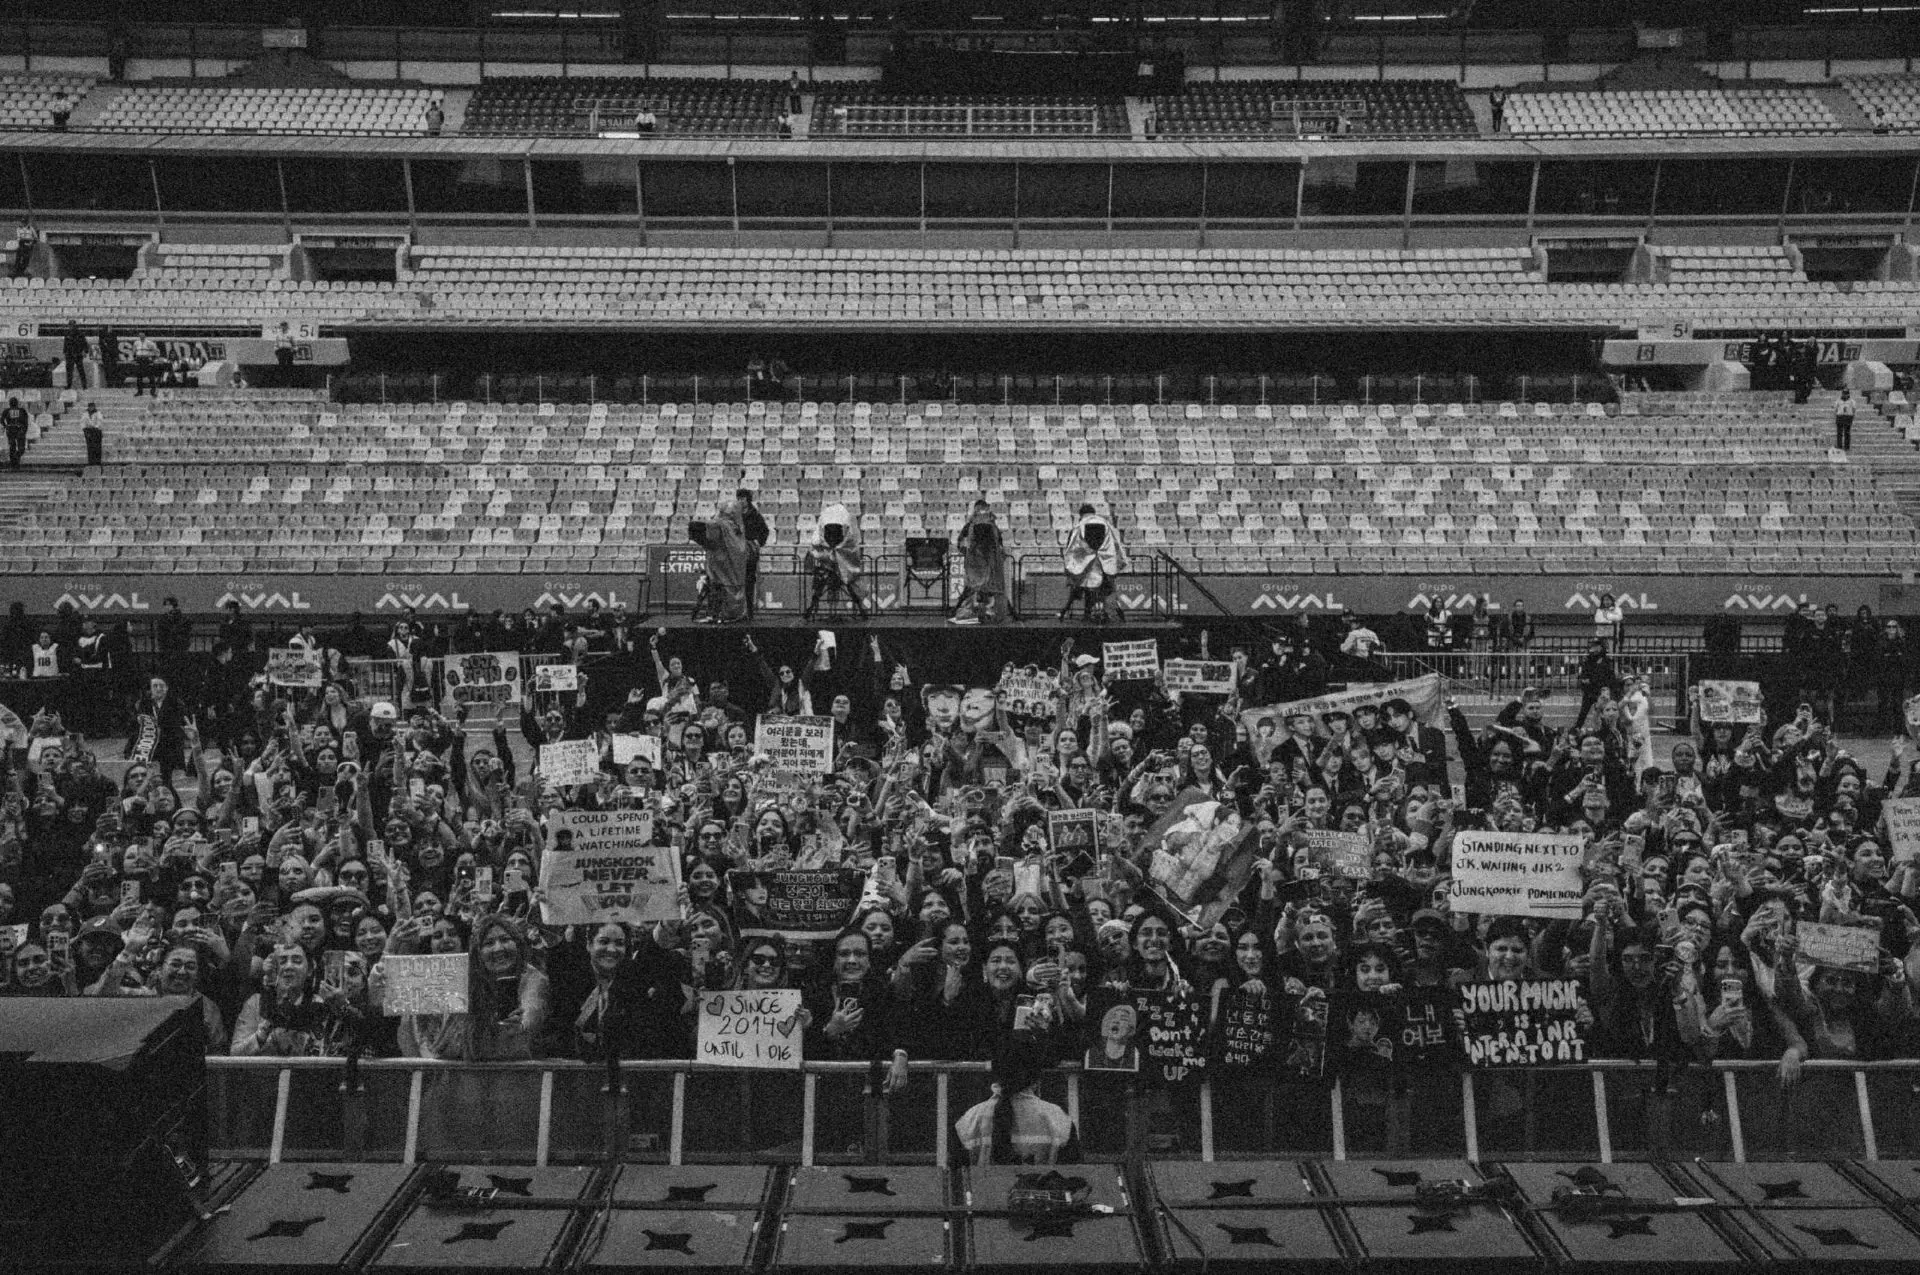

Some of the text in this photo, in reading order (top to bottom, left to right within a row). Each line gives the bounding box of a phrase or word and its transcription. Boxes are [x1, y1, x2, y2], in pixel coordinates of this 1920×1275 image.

[1673, 323, 1683, 338] 5
[1116, 583, 1143, 592] rupo
[1262, 583, 1299, 592] Grupo
[1418, 583, 1455, 592] Grupo
[1576, 583, 1613, 592] Grupo
[53, 592, 149, 609] AVAL
[216, 592, 311, 609] AVAL
[375, 592, 470, 609] AVAL
[1251, 592, 1343, 609] AVAL
[572, 814, 609, 825] COULD
[616, 812, 650, 822] SPEND
[575, 825, 641, 839] A LIFETIME
[578, 838, 642, 851] WATCHING
[1461, 838, 1580, 856] STANDING NEXT TO
[574, 855, 656, 869] JUNGKOOK
[1481, 860, 1527, 874] WAITING
[583, 868, 649, 881] NEVER
[596, 882, 634, 894] LET
[1461, 979, 1580, 1013] YOUR MUSIC
[730, 995, 782, 1015] SINCE
[1406, 1003, 1436, 1022] 내
[717, 1015, 775, 1037] 2014
[1402, 1022, 1447, 1047] 여보
[704, 1041, 792, 1061] UNTIL I DIE
[1163, 1065, 1189, 1081] UP
